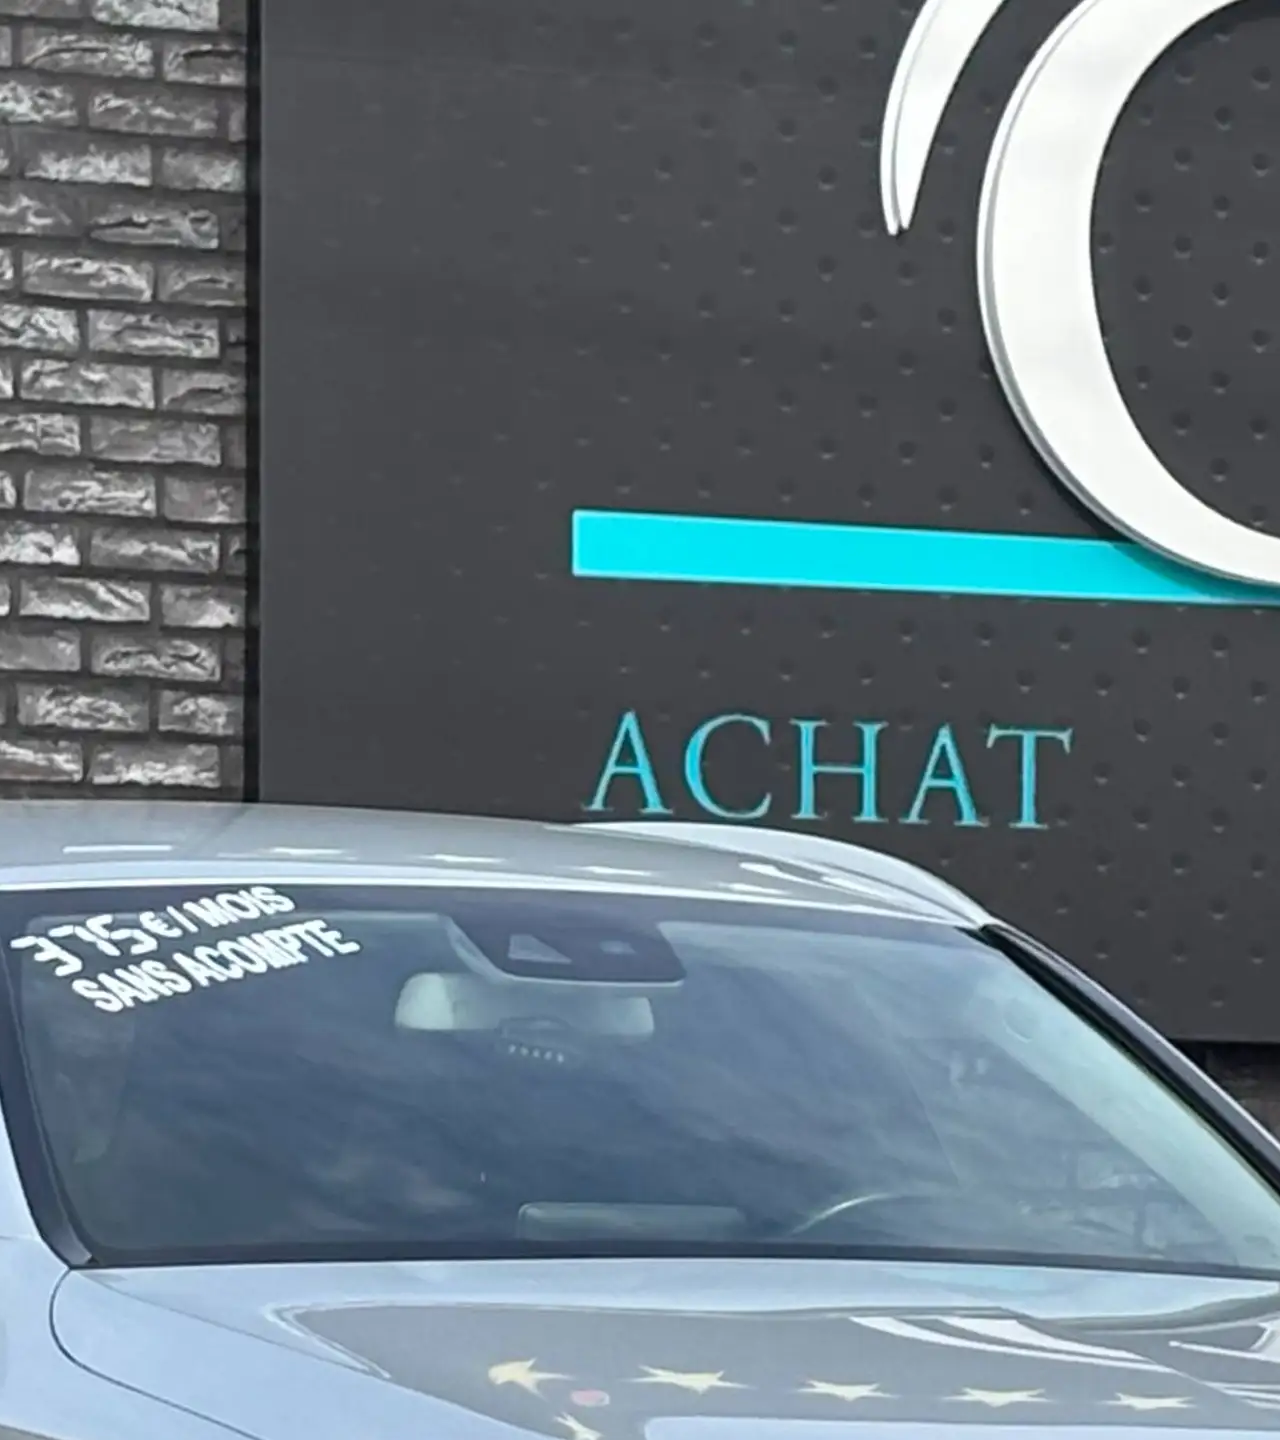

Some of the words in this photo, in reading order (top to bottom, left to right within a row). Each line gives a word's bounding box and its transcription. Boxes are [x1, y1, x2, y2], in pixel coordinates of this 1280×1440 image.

[582, 708, 1074, 830] ACHAT
[71, 960, 193, 1013] SANS
[173, 918, 362, 987] ACOMPTE
